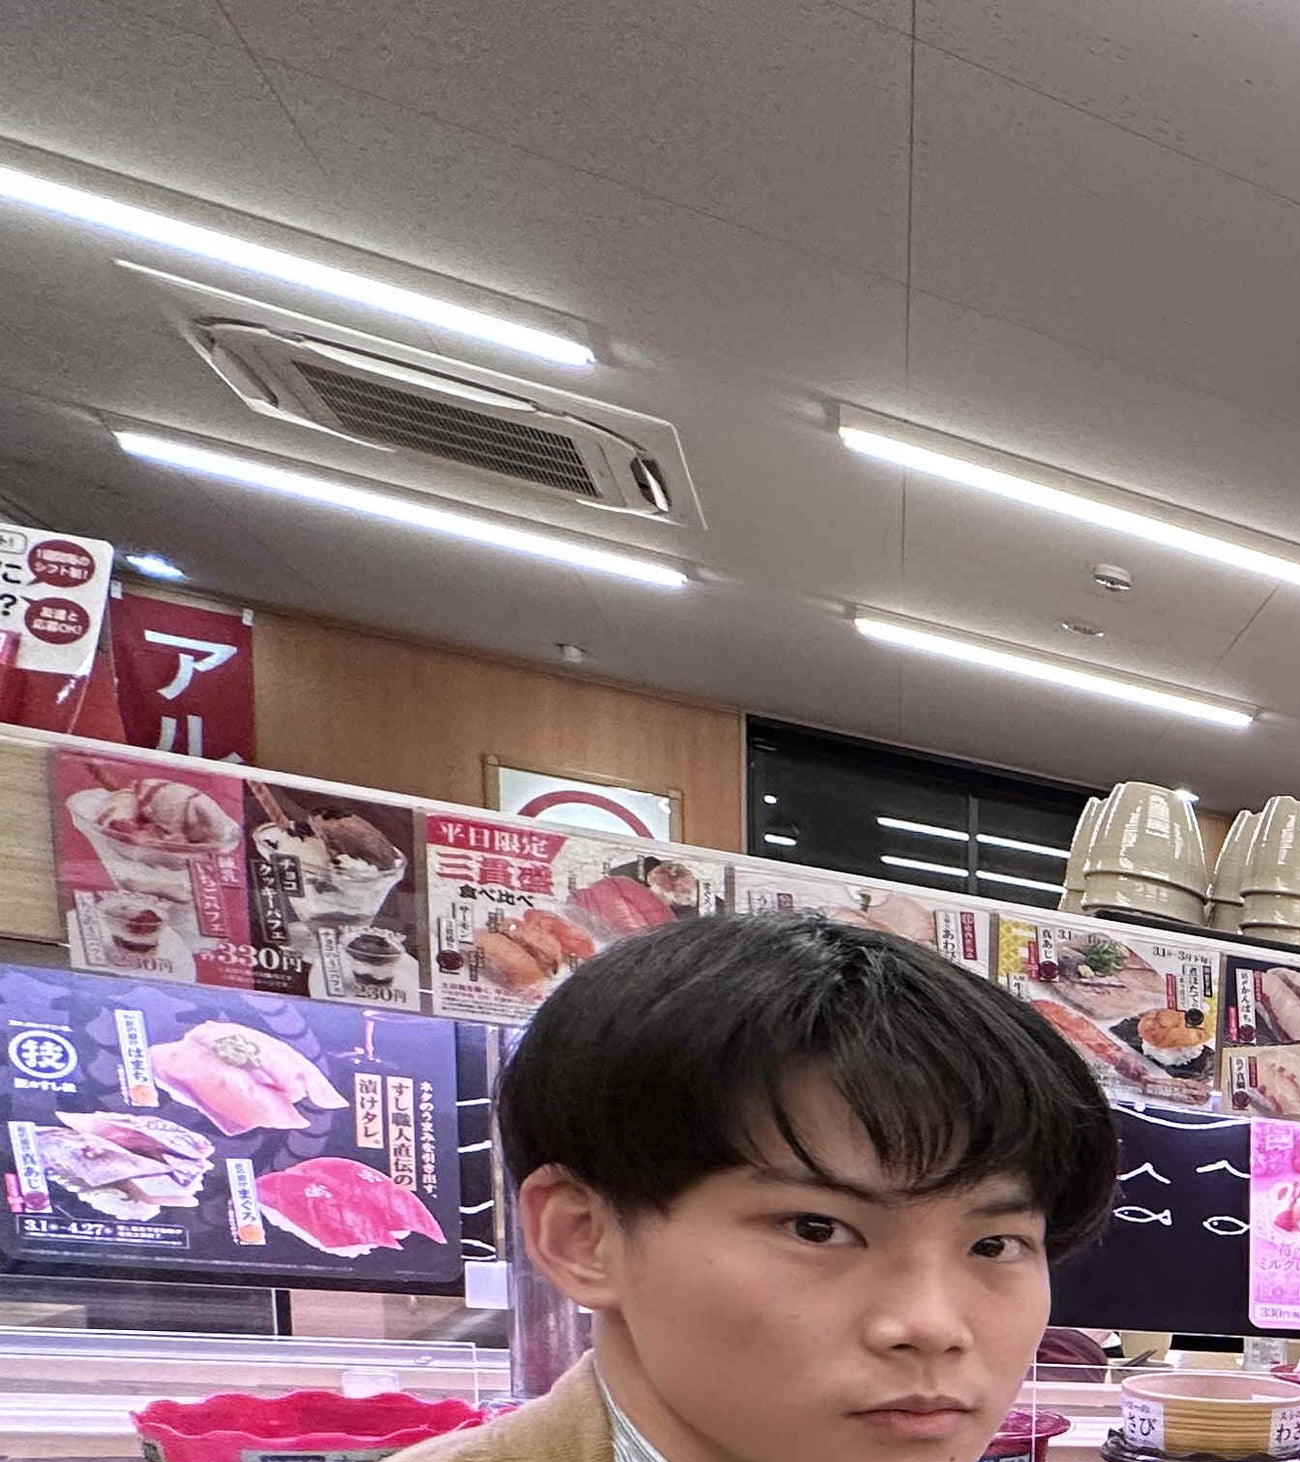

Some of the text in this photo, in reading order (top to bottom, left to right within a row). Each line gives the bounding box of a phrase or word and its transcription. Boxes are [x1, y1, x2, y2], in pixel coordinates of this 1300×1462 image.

[440, 822, 549, 858] 平日限定
[391, 1082, 413, 1187] すし職人直伝の
[1127, 1415, 1157, 1438] さび
